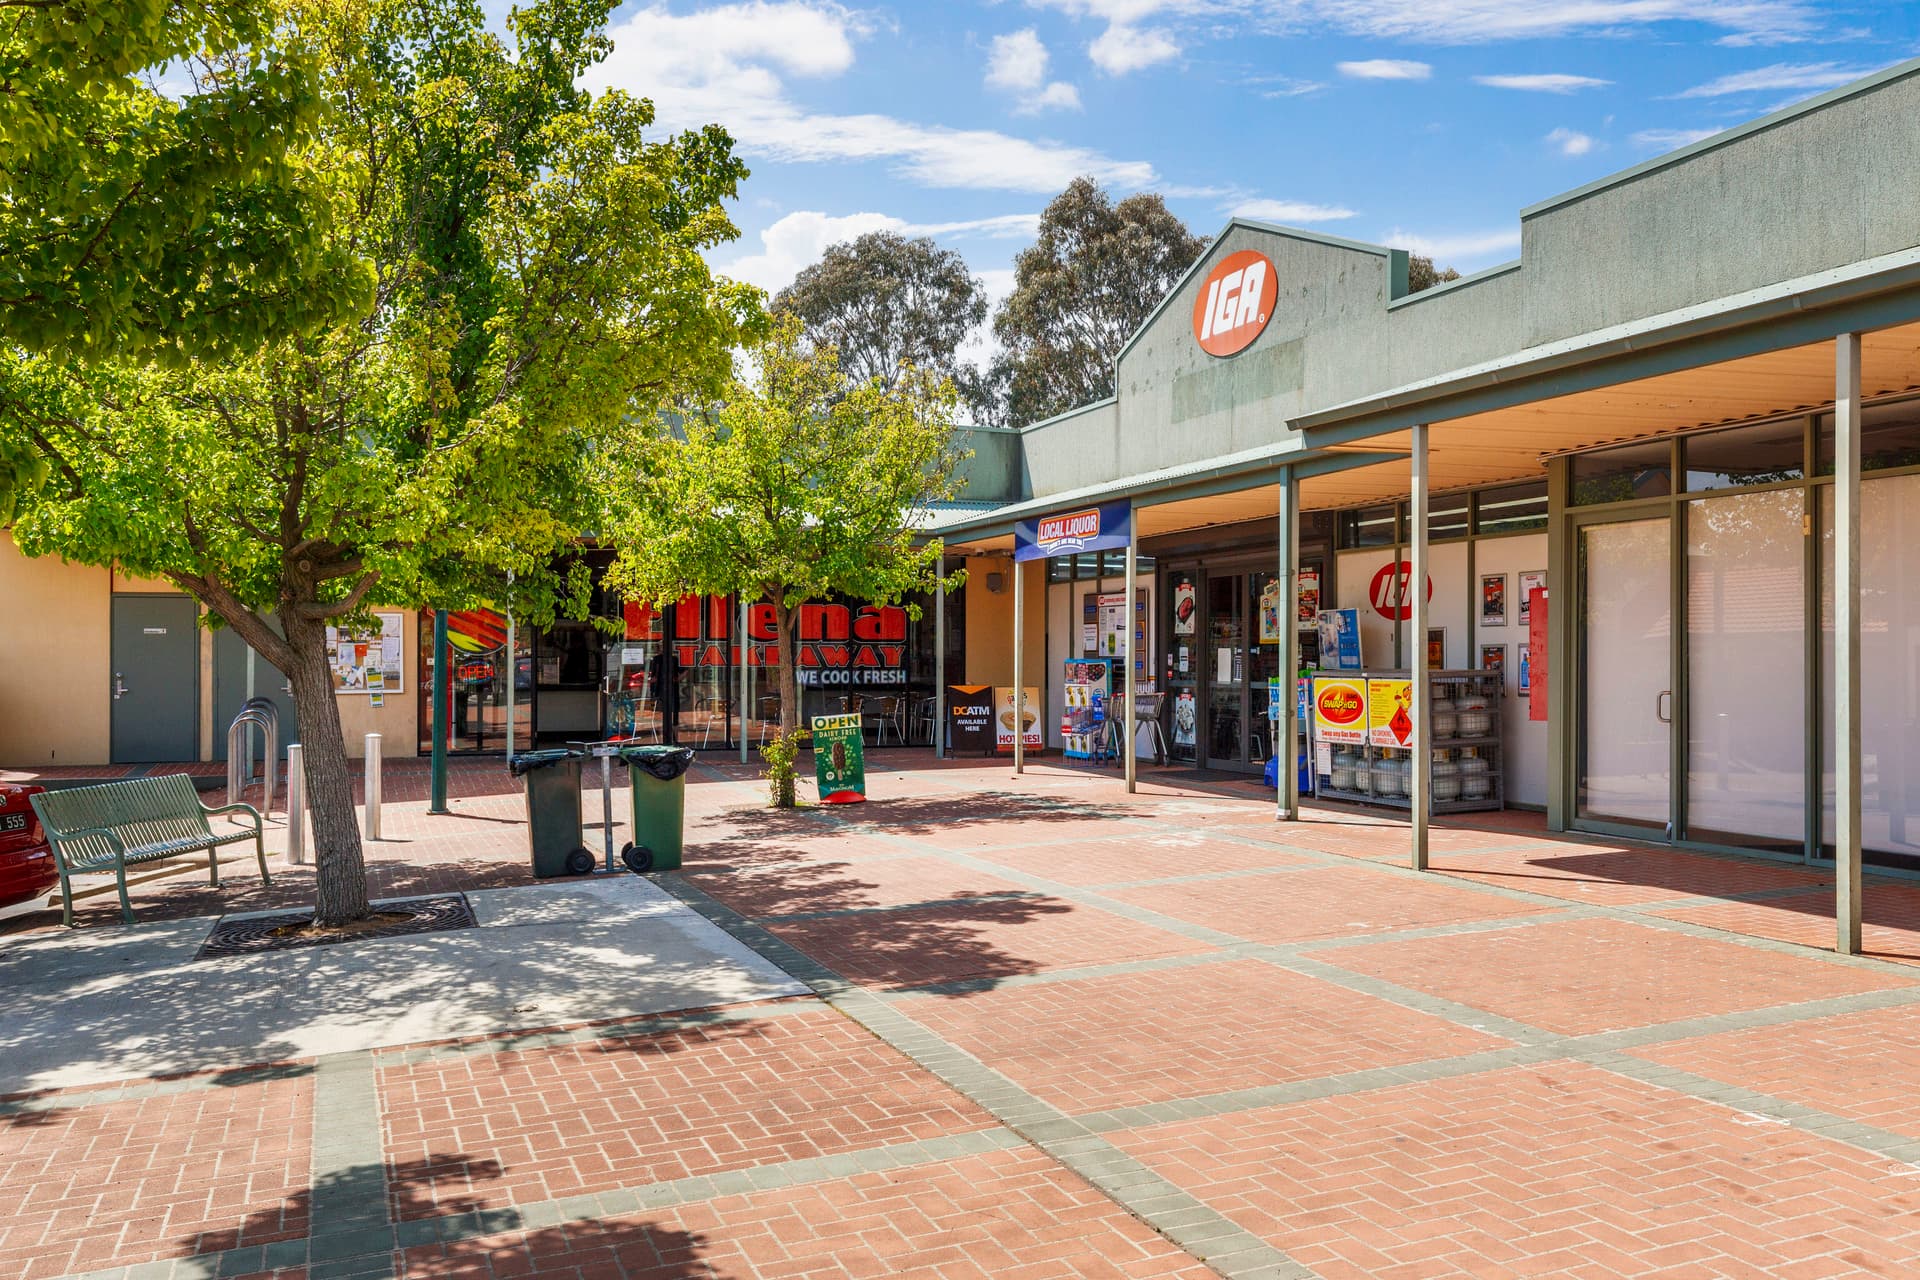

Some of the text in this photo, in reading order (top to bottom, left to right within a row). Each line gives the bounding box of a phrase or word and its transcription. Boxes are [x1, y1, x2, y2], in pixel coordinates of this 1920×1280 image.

[1200, 260, 1267, 341] IGA
[1040, 521, 1065, 541] LOCAL
[457, 665, 494, 679] OPEN
[796, 670, 906, 684] WE COOK FRESH
[814, 715, 859, 730] OPEN
[818, 728, 857, 739] DAIRY FREE
[6, 815, 25, 829] 555
